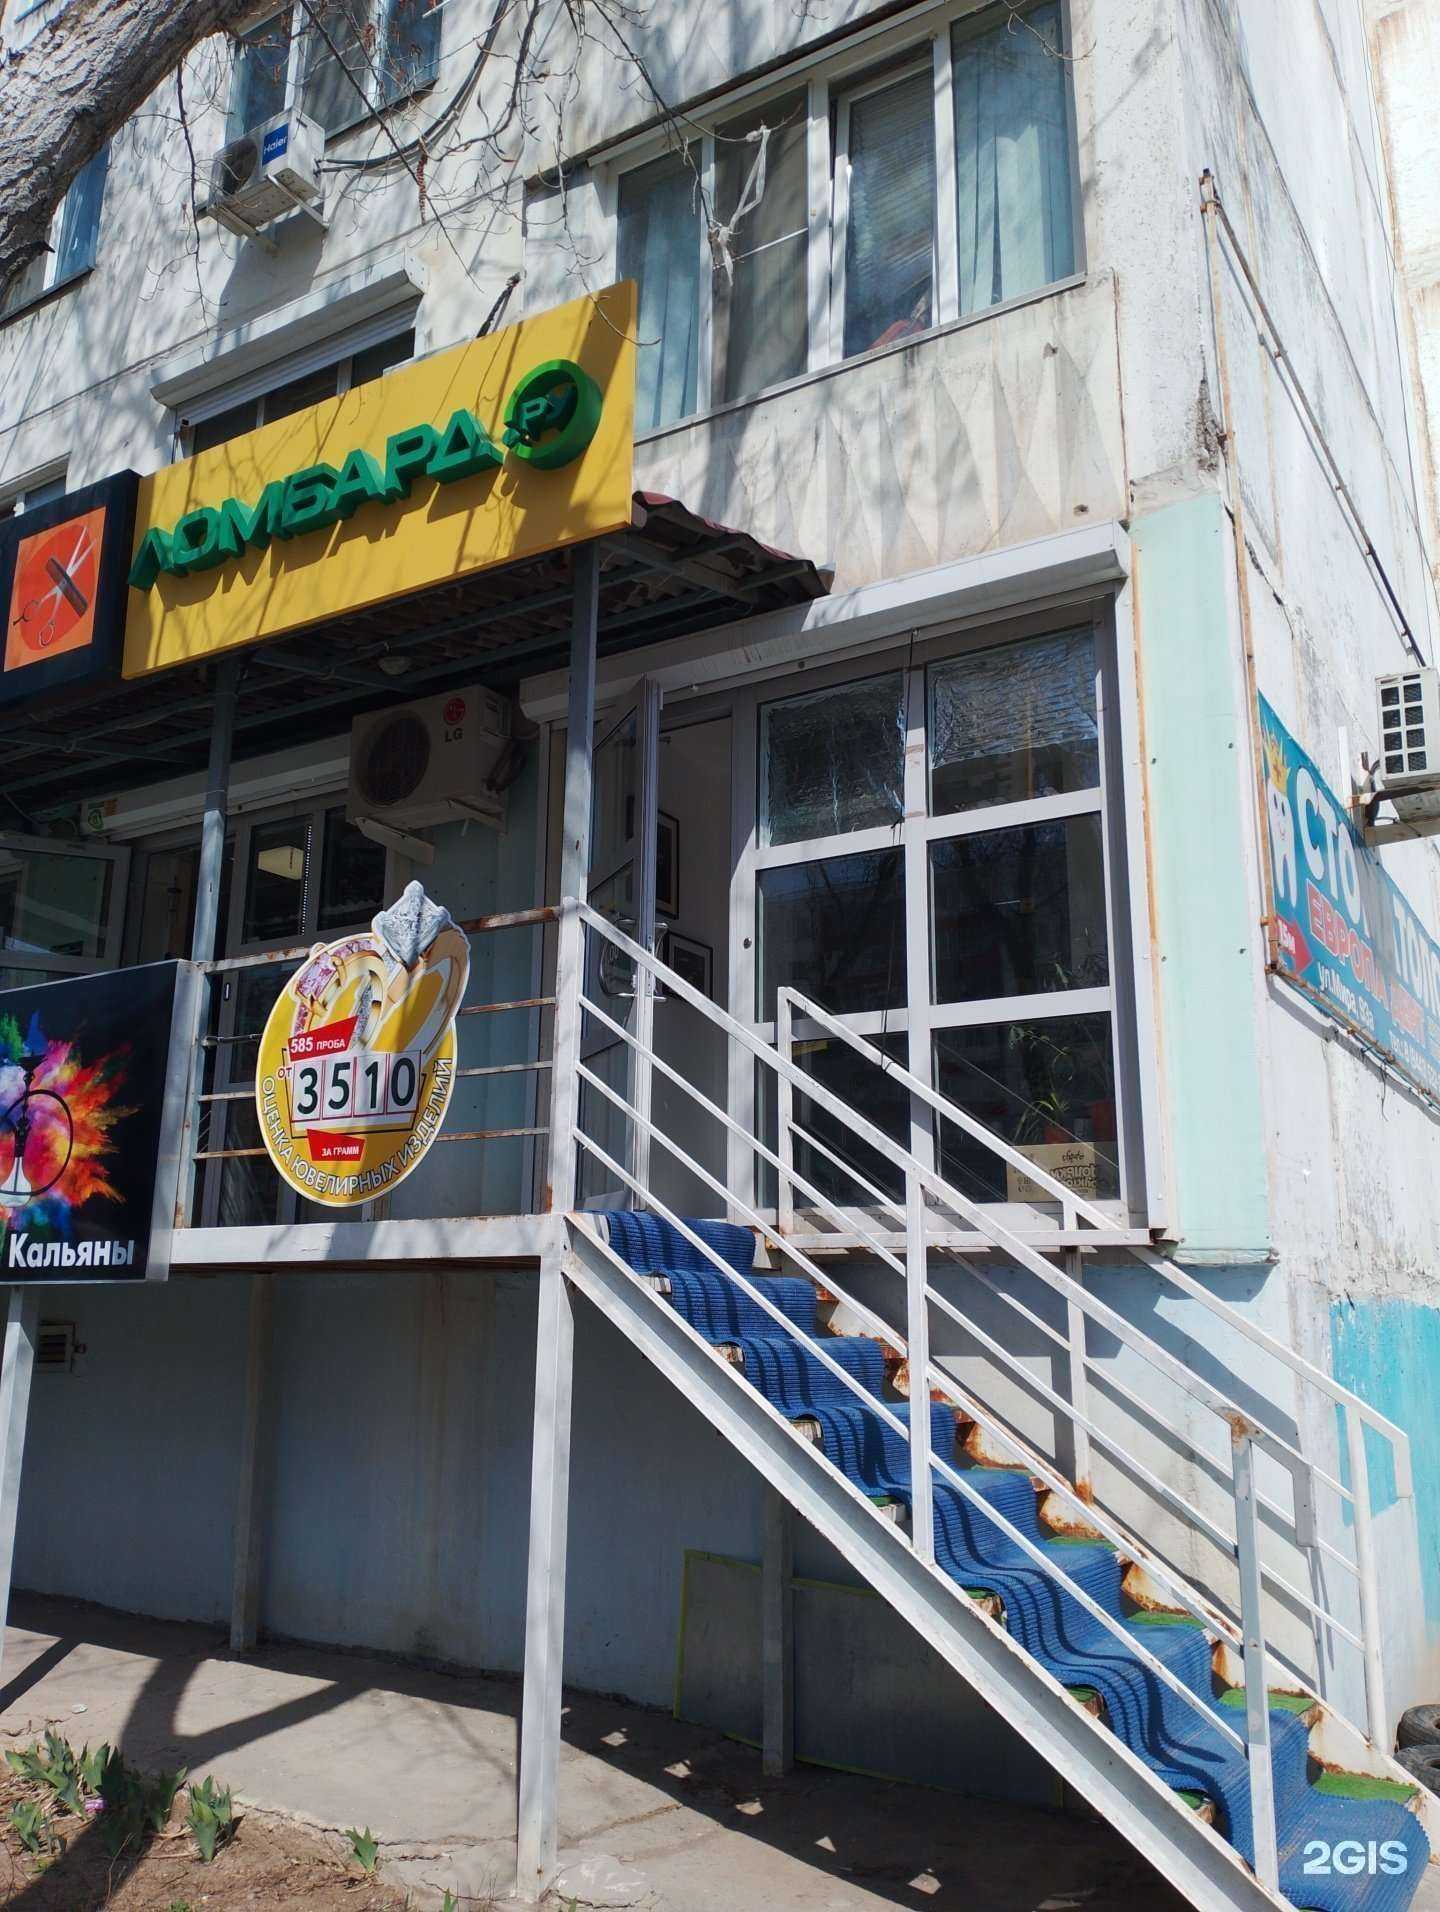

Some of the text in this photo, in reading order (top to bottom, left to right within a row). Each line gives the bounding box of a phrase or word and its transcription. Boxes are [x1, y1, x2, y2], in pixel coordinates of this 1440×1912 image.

[263, 135, 288, 155] Haier
[129, 408, 504, 592] ЛОМБАРД
[444, 727, 464, 743] LG
[290, 1037, 345, 1053] 585 ПРОБА
[296, 1057, 416, 1115] 3510
[262, 1057, 453, 1196] ОЦЕНКА ЮВЕЛИРНЫХ ИЗДЕЛИЙ
[321, 1146, 360, 1157] ЗА ГРАММ
[8, 1232, 135, 1269] Кальяны
